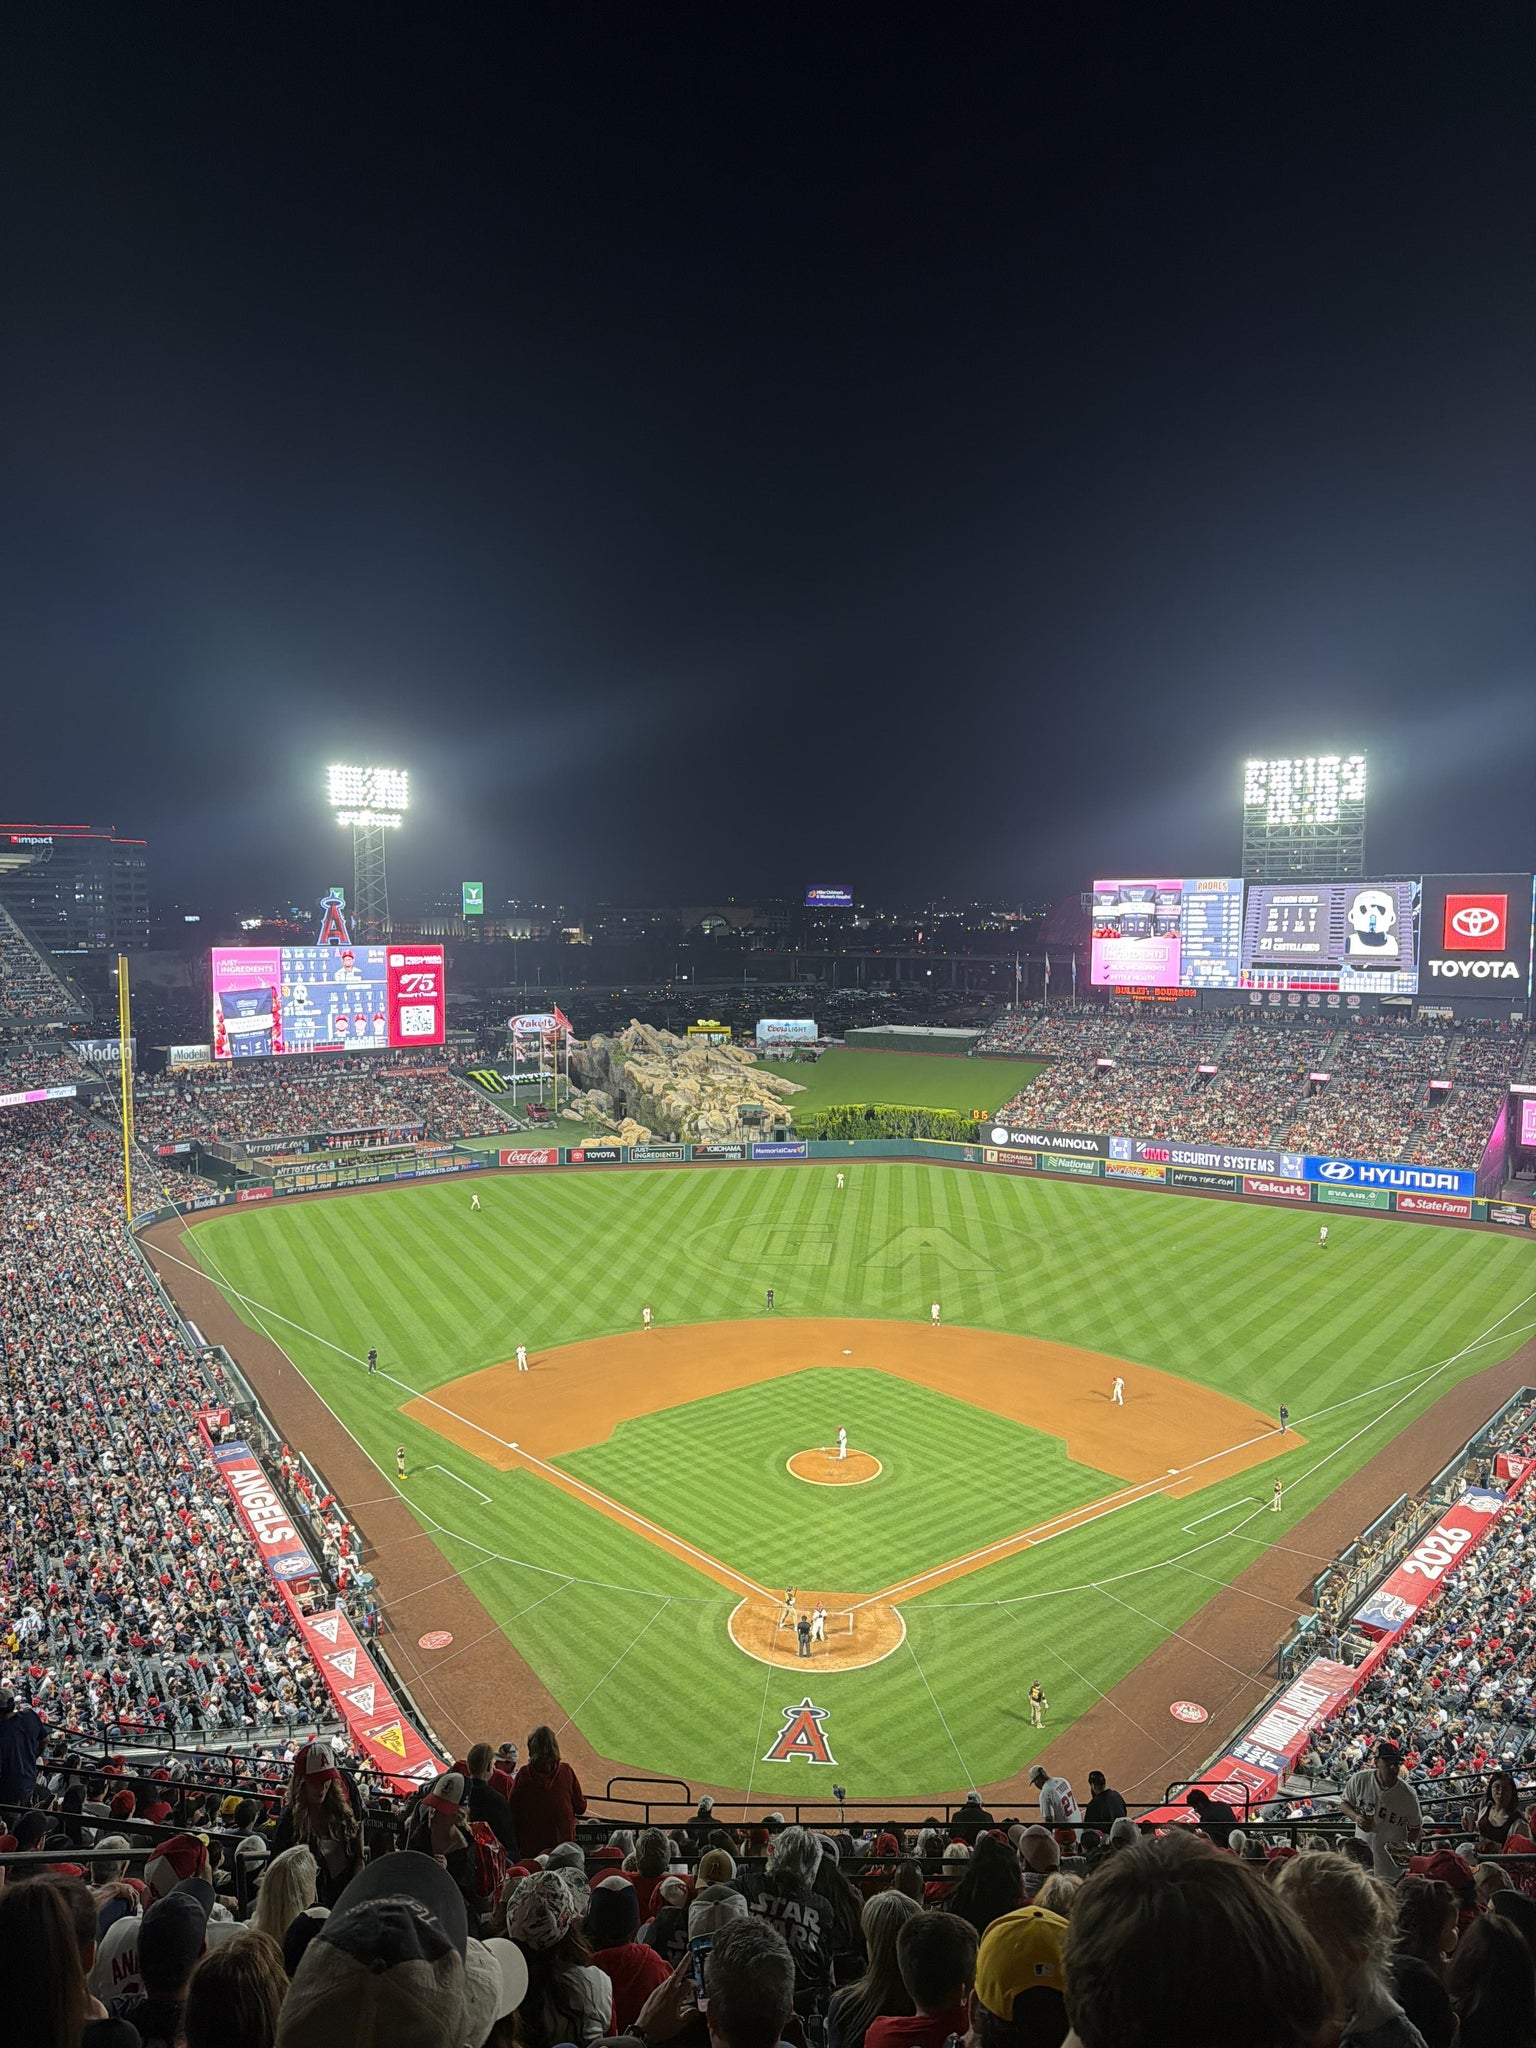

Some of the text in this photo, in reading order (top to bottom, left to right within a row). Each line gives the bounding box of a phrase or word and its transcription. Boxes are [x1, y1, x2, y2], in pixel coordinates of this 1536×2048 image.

[1197, 881, 1227, 891] PADRES
[1428, 960, 1520, 978] TOYOTA
[519, 1019, 554, 1029] Yakult
[79, 1043, 133, 1062] Modelo
[174, 1048, 208, 1061] Modelo
[1010, 1132, 1051, 1147] KONICA
[1052, 1137, 1099, 1151] MINOLTA
[585, 1151, 617, 1159] TOYOTA
[999, 1152, 1033, 1161] PECHANGA
[1057, 1157, 1094, 1170] National
[1142, 1147, 1170, 1162] JMG
[1171, 1150, 1221, 1167] SECURITY
[1223, 1155, 1275, 1172] SYSTEMS
[1109, 1163, 1143, 1176] Surfside
[1174, 1173, 1234, 1187] NITTO TIRE.COM
[1360, 1166, 1459, 1191] HYUNDAI
[1247, 1179, 1307, 1196] Yakult
[1351, 1191, 1366, 1199] AIR
[194, 1198, 217, 1209] Modelo
[226, 1468, 296, 1545] ANGELS
[1402, 1525, 1473, 1581] 2026
[1248, 1708, 1307, 1752] BOMBER
[1061, 1791, 1077, 1817] 27
[749, 1892, 821, 1935] STAR
